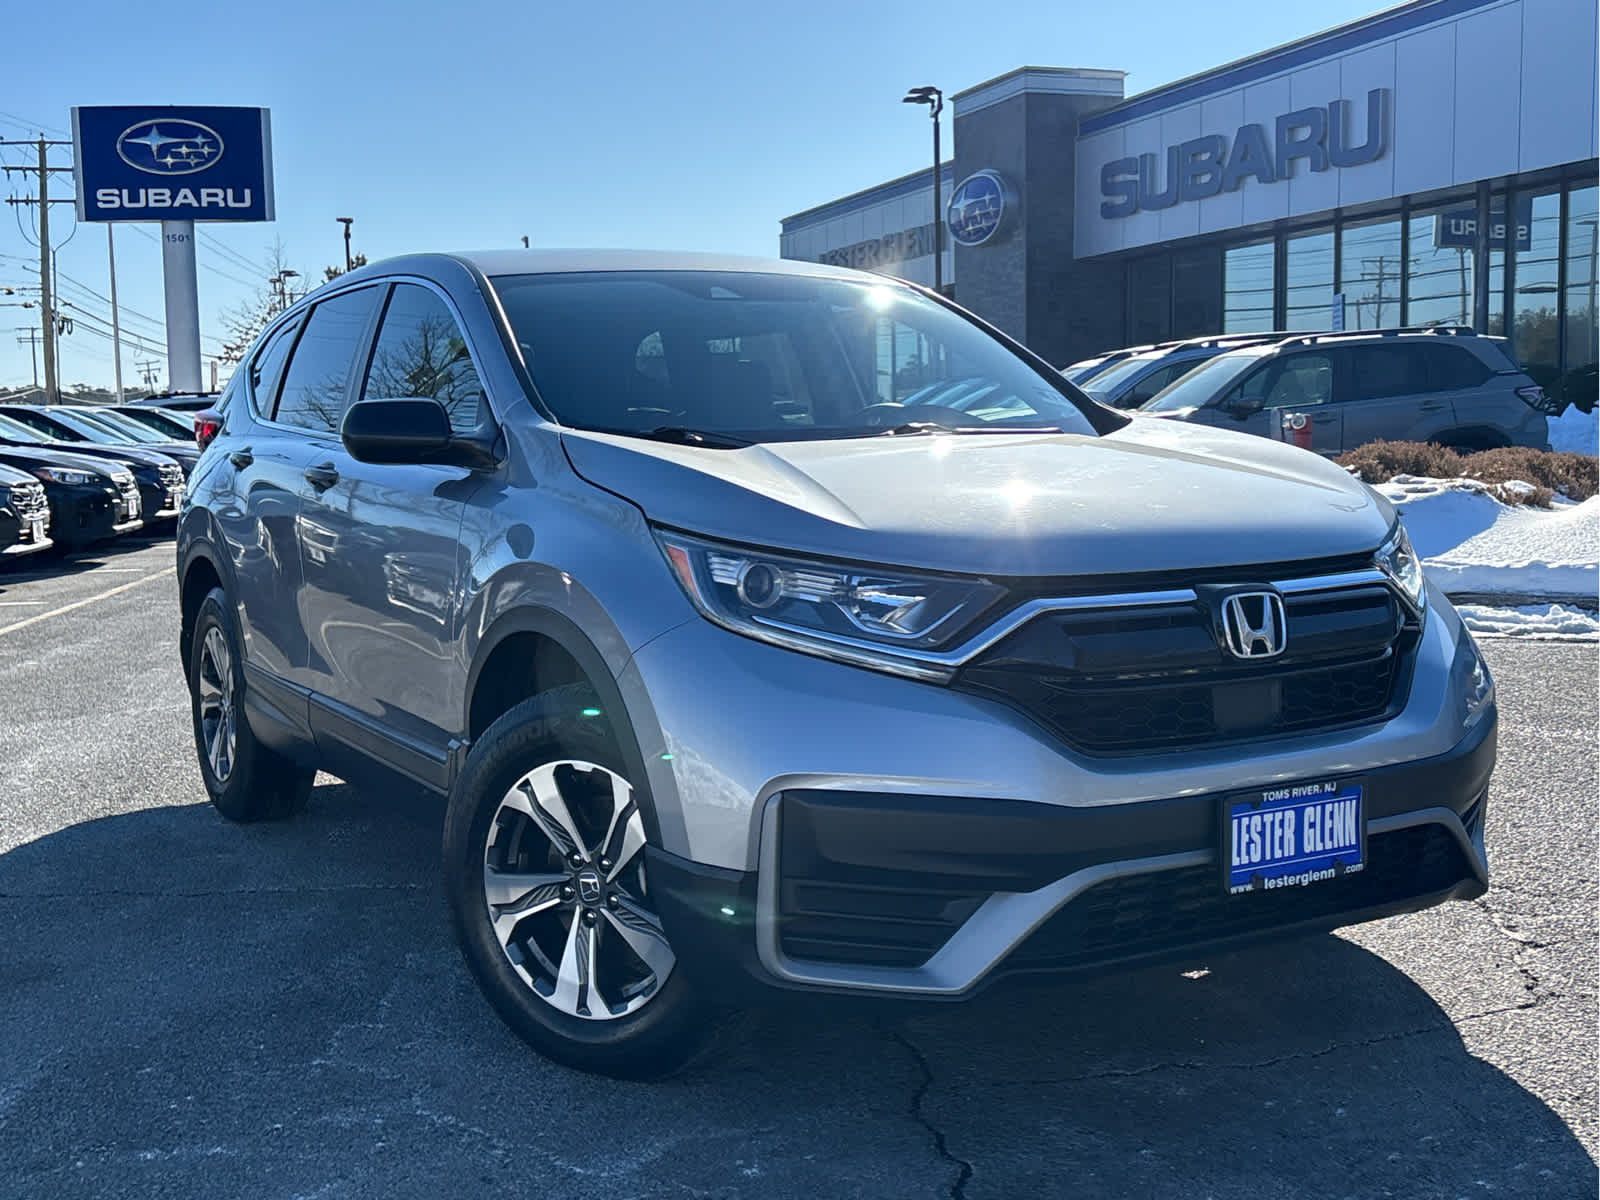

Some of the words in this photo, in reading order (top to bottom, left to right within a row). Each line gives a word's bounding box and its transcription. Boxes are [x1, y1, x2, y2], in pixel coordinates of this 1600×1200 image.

[1100, 88, 1391, 220] SUBARU
[96, 188, 252, 208] SUBARU
[166, 234, 191, 243] 1501
[1262, 789, 1290, 802] TOMS
[1324, 782, 1337, 793] NJ
[1231, 809, 1296, 867] LESTER
[1303, 799, 1357, 853] GLENN
[1263, 868, 1336, 889] lesterglenn
